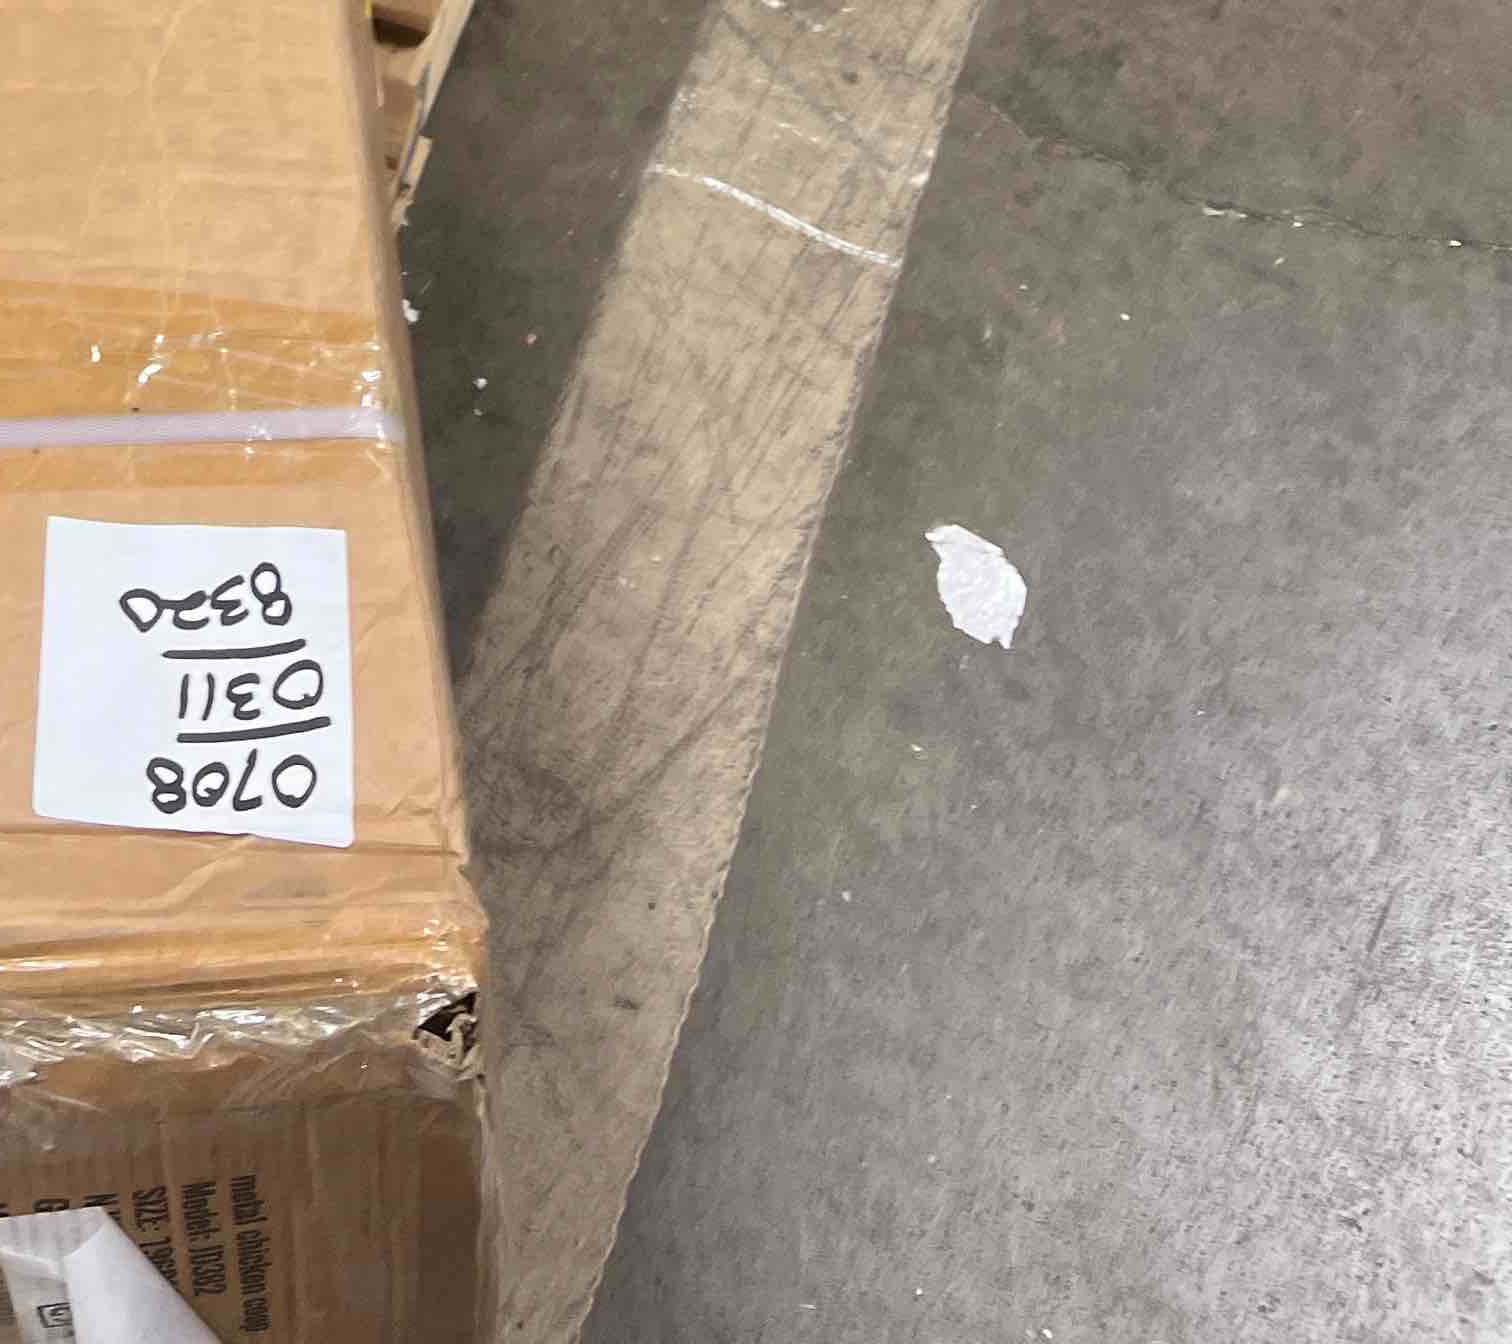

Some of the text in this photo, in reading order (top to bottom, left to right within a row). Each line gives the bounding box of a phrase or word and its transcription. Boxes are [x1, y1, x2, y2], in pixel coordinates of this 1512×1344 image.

[118, 562, 292, 634] 8320
[178, 659, 324, 721] 0311
[146, 748, 317, 815] 0708
[131, 1185, 172, 1233] SIZE:
[182, 1181, 220, 1243] Model:
[231, 1174, 274, 1334] metal chicken coop
